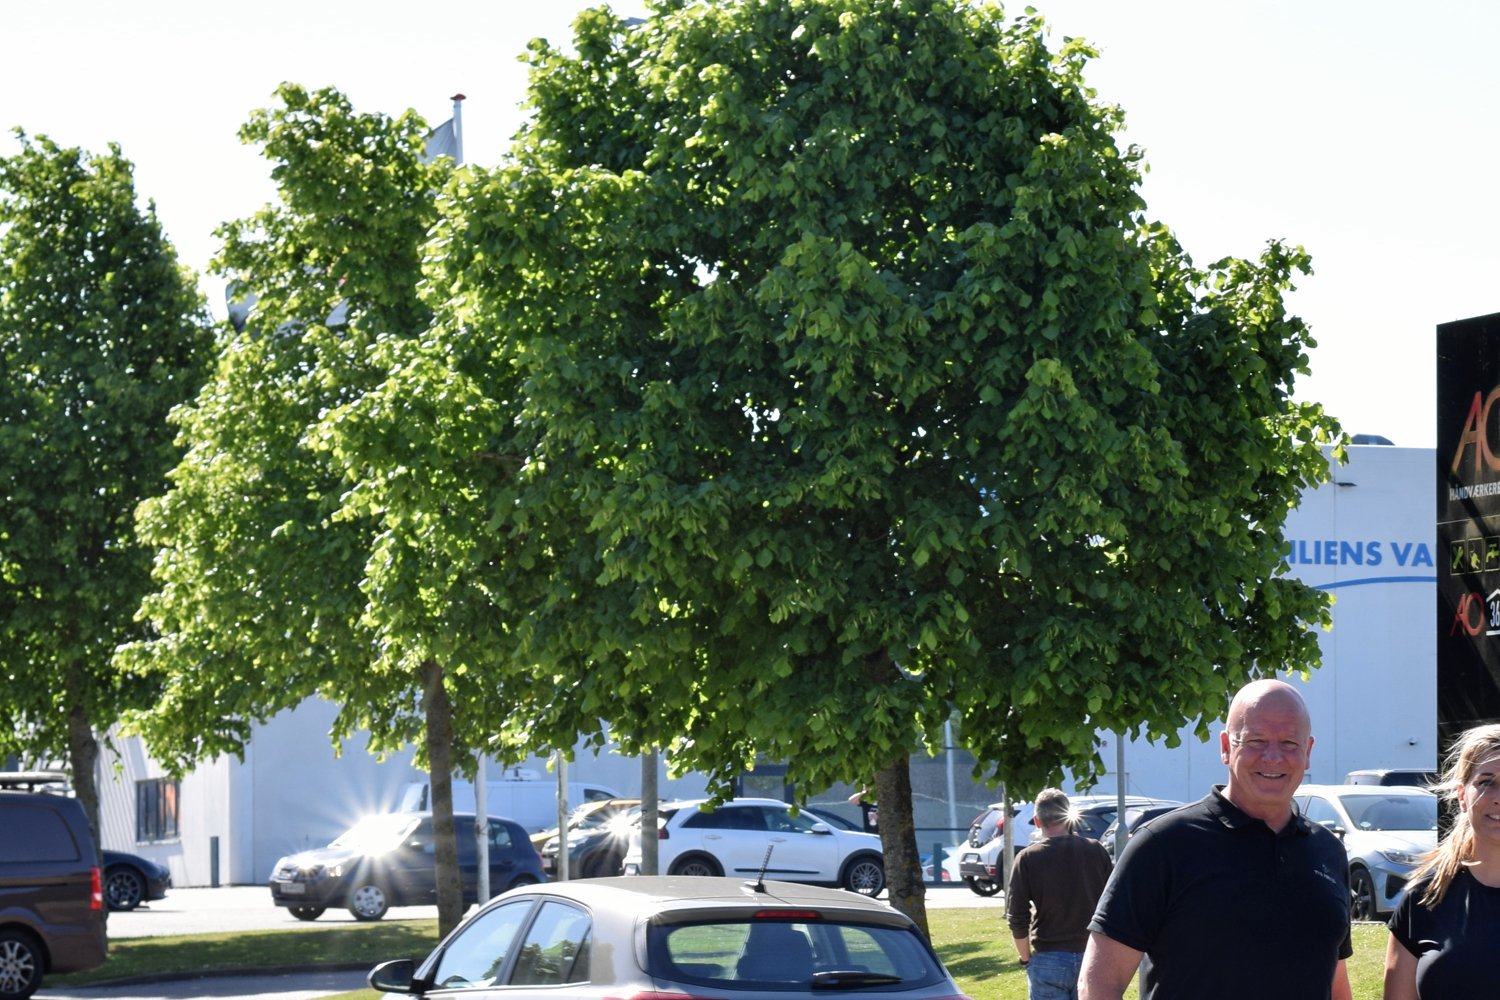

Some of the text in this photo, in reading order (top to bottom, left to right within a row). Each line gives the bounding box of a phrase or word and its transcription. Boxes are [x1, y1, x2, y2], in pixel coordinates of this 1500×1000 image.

[1281, 540, 1436, 567] ILIENS VA
[1450, 591, 1485, 636] AO
